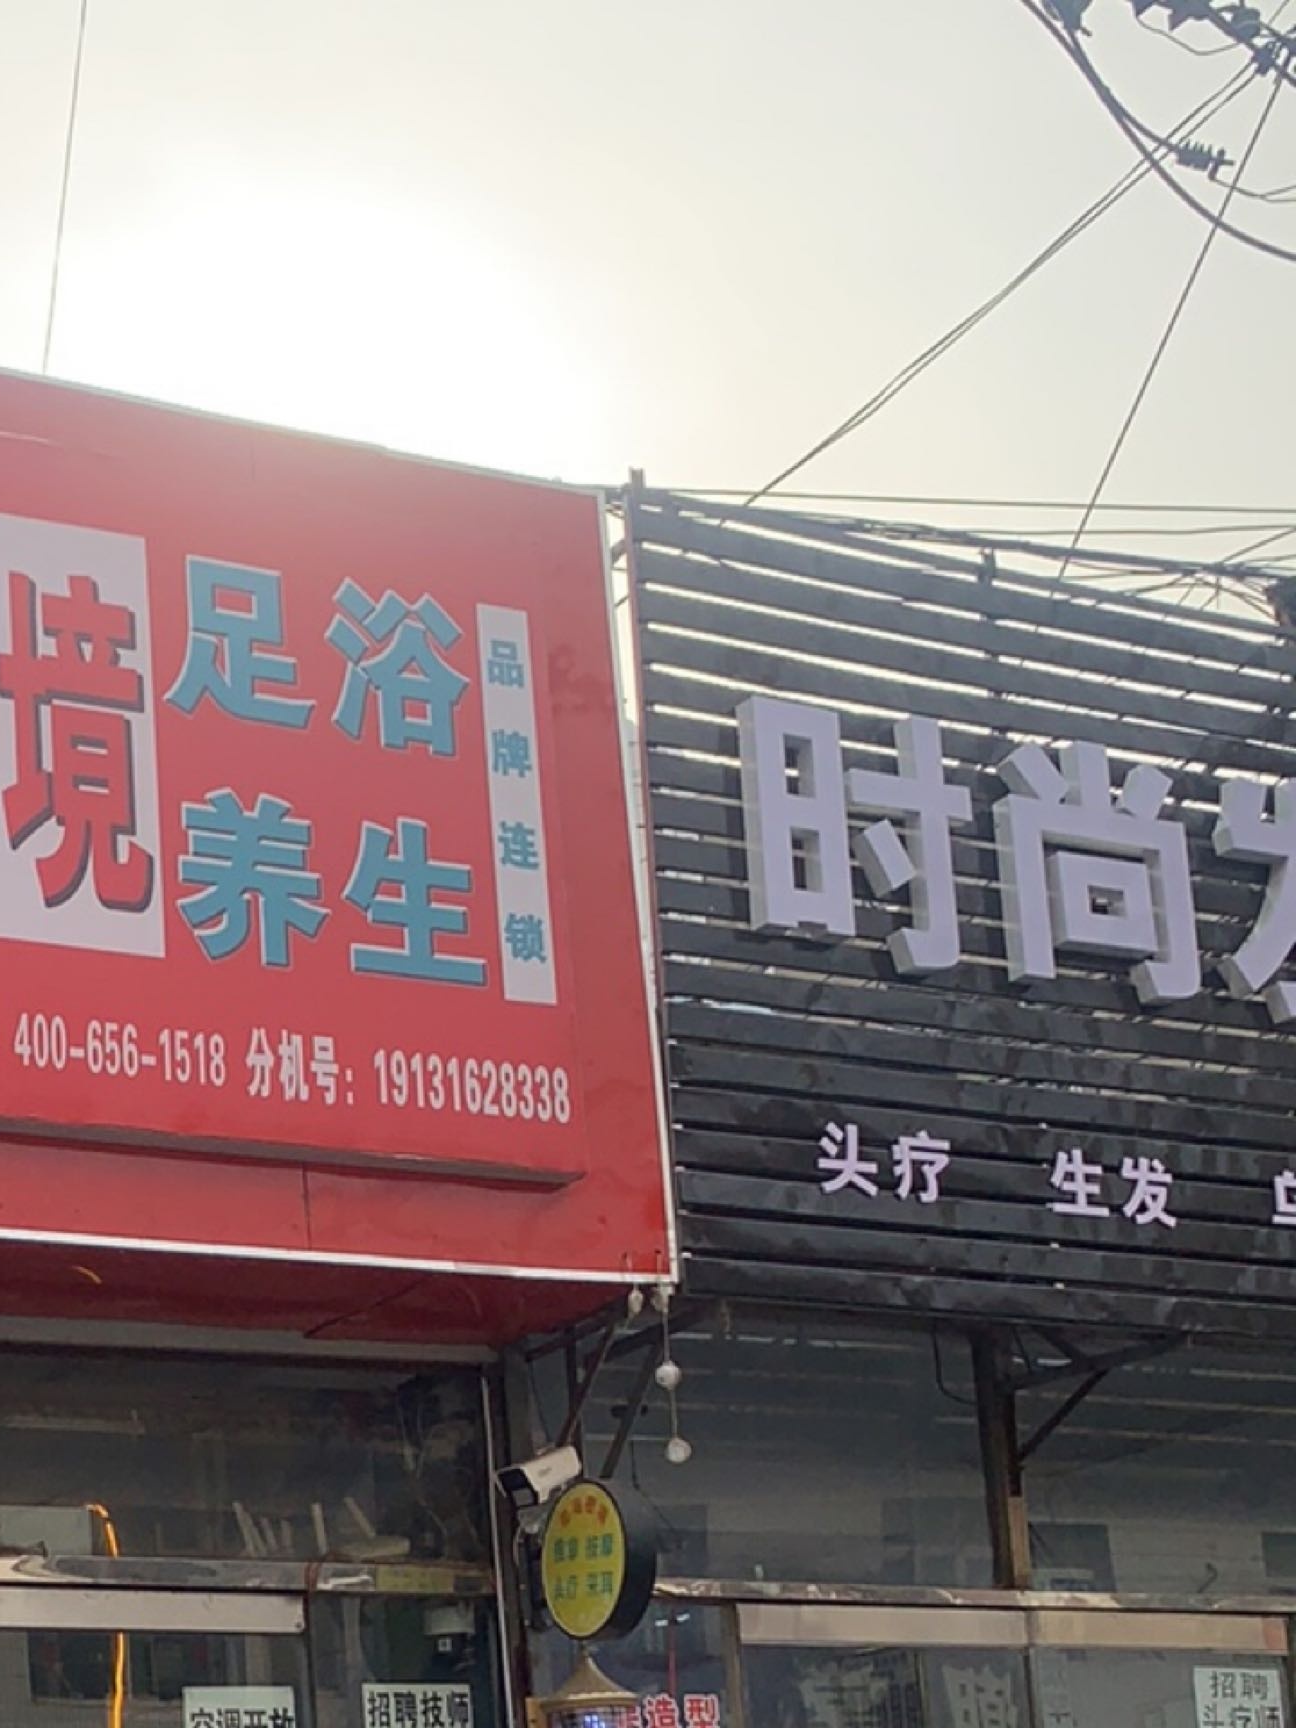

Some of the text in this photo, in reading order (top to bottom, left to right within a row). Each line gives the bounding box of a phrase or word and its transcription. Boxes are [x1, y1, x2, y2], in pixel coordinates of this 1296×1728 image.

[164, 552, 470, 758] 足浴
[488, 639, 546, 963] 品牌连锁
[178, 789, 488, 990] 养生
[14, 1012, 226, 1086] 400-656-1518
[374, 1049, 571, 1124] 19131628338
[816, 1121, 952, 1203] 头疗
[1046, 1148, 1178, 1228] 生发
[367, 1690, 470, 1728] 招聘技师
[1209, 1670, 1269, 1700] 招聘
